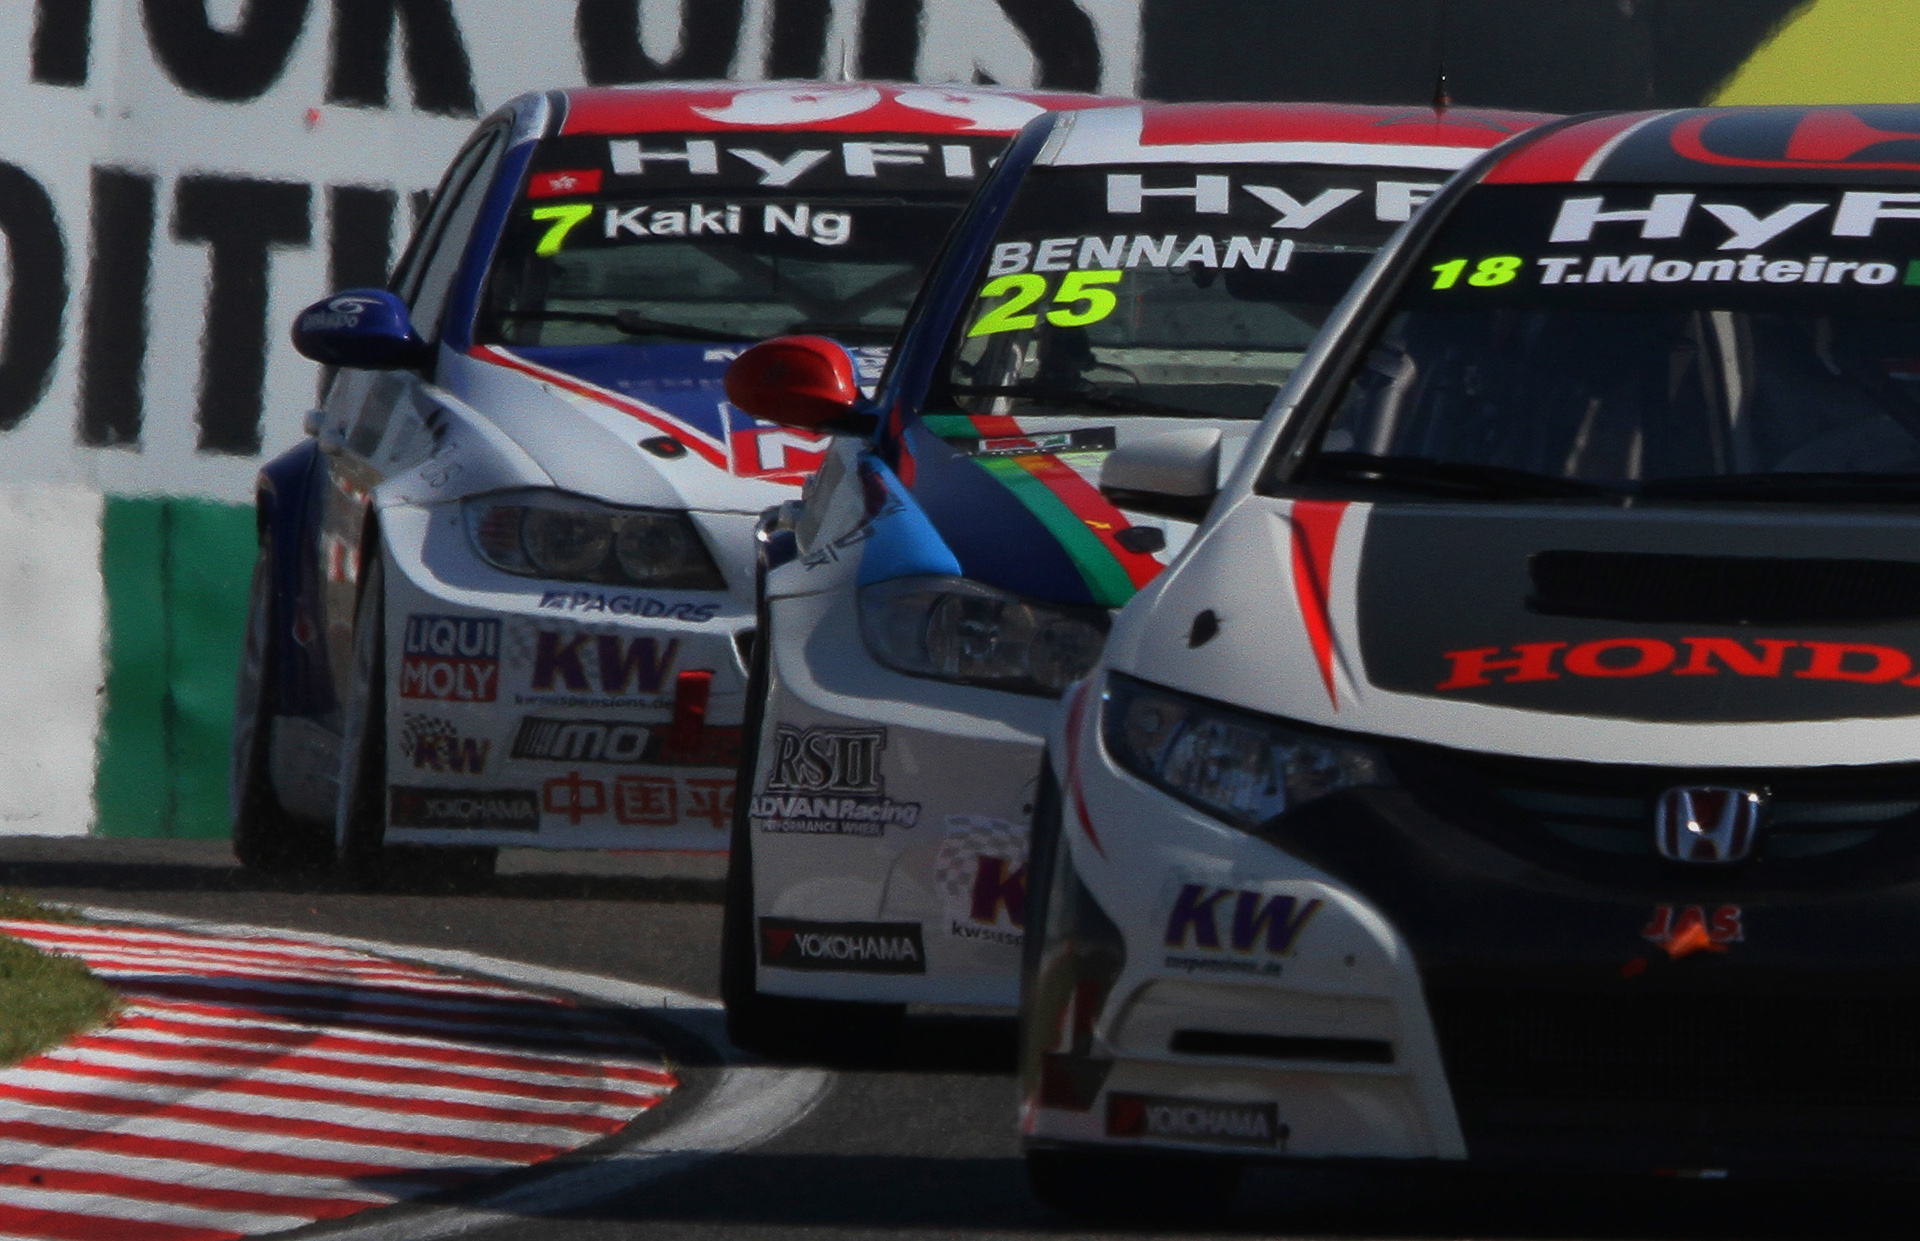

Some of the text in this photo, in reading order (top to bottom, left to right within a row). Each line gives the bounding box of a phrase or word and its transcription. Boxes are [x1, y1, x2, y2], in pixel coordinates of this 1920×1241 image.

[609, 139, 998, 187] HyFI
[532, 203, 852, 258] 7 Kaki Ng
[987, 234, 1296, 278] BENNANI
[1430, 254, 1898, 290] 18 T.Monteiro
[966, 270, 1124, 338] 25
[406, 618, 497, 656] LIQUI
[401, 660, 497, 700] MOLY
[530, 630, 684, 695] KW
[1436, 636, 1920, 692] HOND
[413, 732, 491, 775] KW
[1164, 883, 1326, 958] KW
[1641, 903, 1745, 942] JAS
[796, 934, 918, 961] YOKOHAMA
[1147, 1104, 1271, 1139] YOKOHAMA
